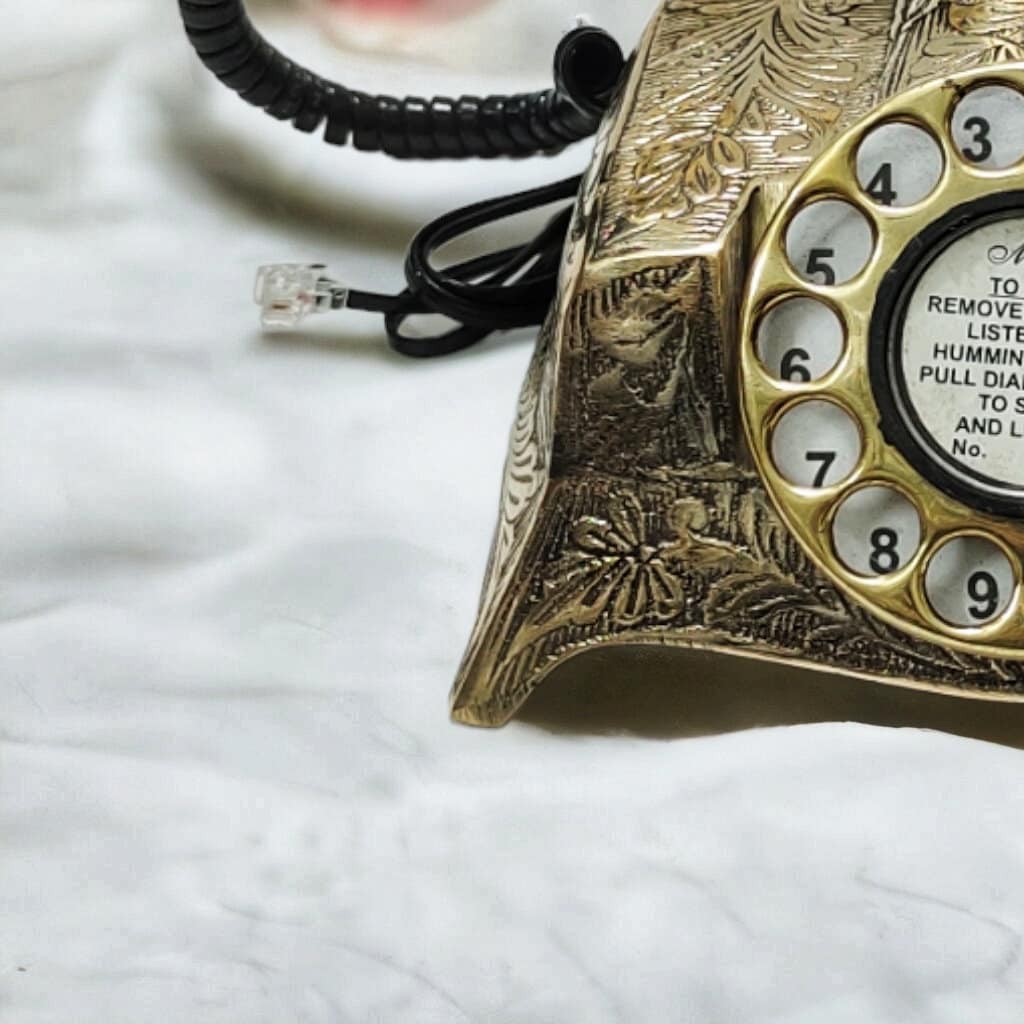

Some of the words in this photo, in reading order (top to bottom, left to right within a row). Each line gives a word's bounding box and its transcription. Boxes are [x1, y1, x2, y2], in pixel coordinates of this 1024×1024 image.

[961, 116, 993, 163] 3
[865, 163, 896, 206] 4
[805, 248, 836, 286] 5
[990, 277, 1019, 296] TO
[927, 295, 1022, 320] REMOVE
[778, 348, 812, 384] 6
[920, 366, 976, 386] PULL
[978, 394, 1008, 413] TO
[954, 417, 1002, 436] AND
[952, 439, 987, 458] No.
[805, 451, 836, 487] 7
[868, 527, 899, 574] 8
[966, 571, 999, 619] 9
